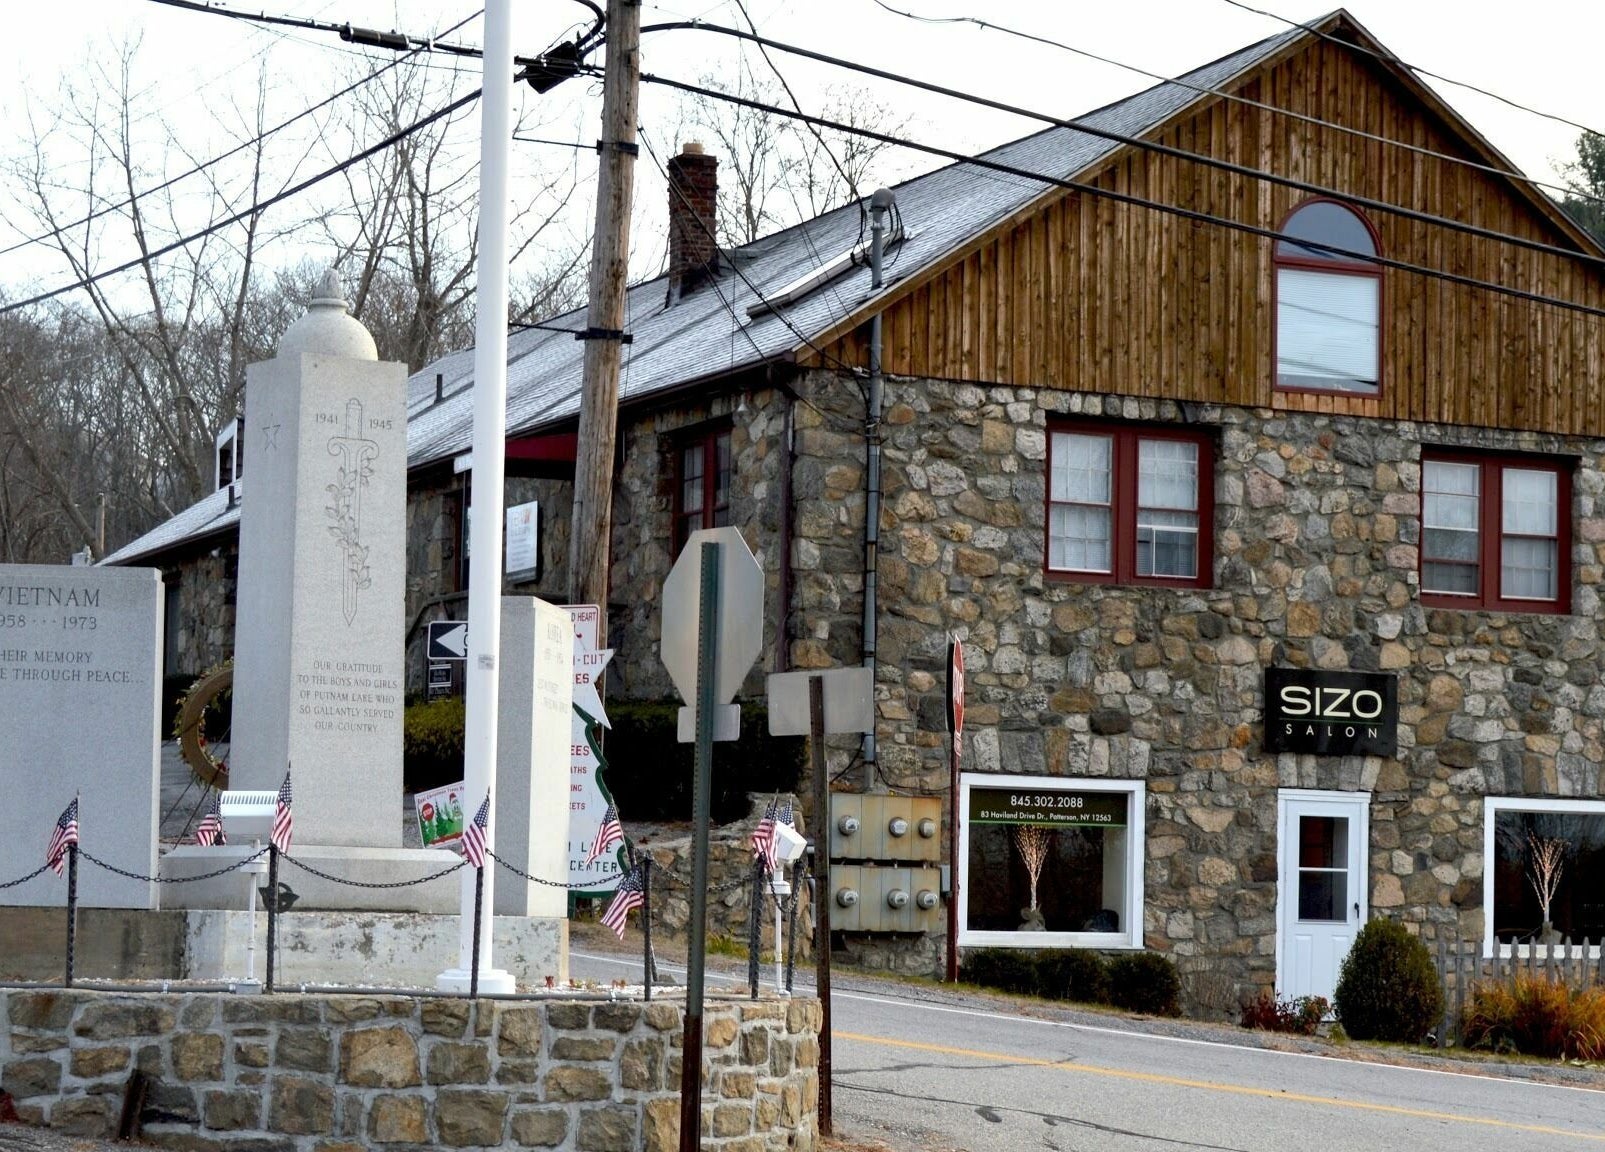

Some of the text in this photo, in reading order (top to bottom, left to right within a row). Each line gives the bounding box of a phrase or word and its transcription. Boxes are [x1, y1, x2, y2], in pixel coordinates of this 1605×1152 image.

[315, 413, 393, 430] 1941 1945
[63, 616, 97, 630] 1973
[577, 611, 597, 622] HEART
[34, 650, 94, 664] MEMORY
[313, 660, 384, 674] OUR GRATITUDE
[13, 668, 81, 681] THROUGH
[296, 674, 398, 689] TO THE BOYS AND GIRLS
[575, 673, 589, 685] ES
[299, 690, 395, 704] OF PUTNAM LAKE WHO
[1280, 685, 1383, 719] SIZO
[299, 704, 394, 719] SO GALLANTLY SERVED
[314, 720, 378, 733] OUR COUNTRY
[1285, 723, 1378, 738] SALON
[1010, 795, 1084, 808] 845.302.2088
[980, 810, 990, 818] 83
[990, 811, 1018, 820] Haviland
[1019, 812, 1036, 820] Drive
[1049, 813, 1079, 822] Patterson,
[1080, 813, 1090, 821] NY
[1092, 814, 1112, 822] 12563
[581, 841, 612, 854] LE
[569, 860, 618, 873] CENTER
